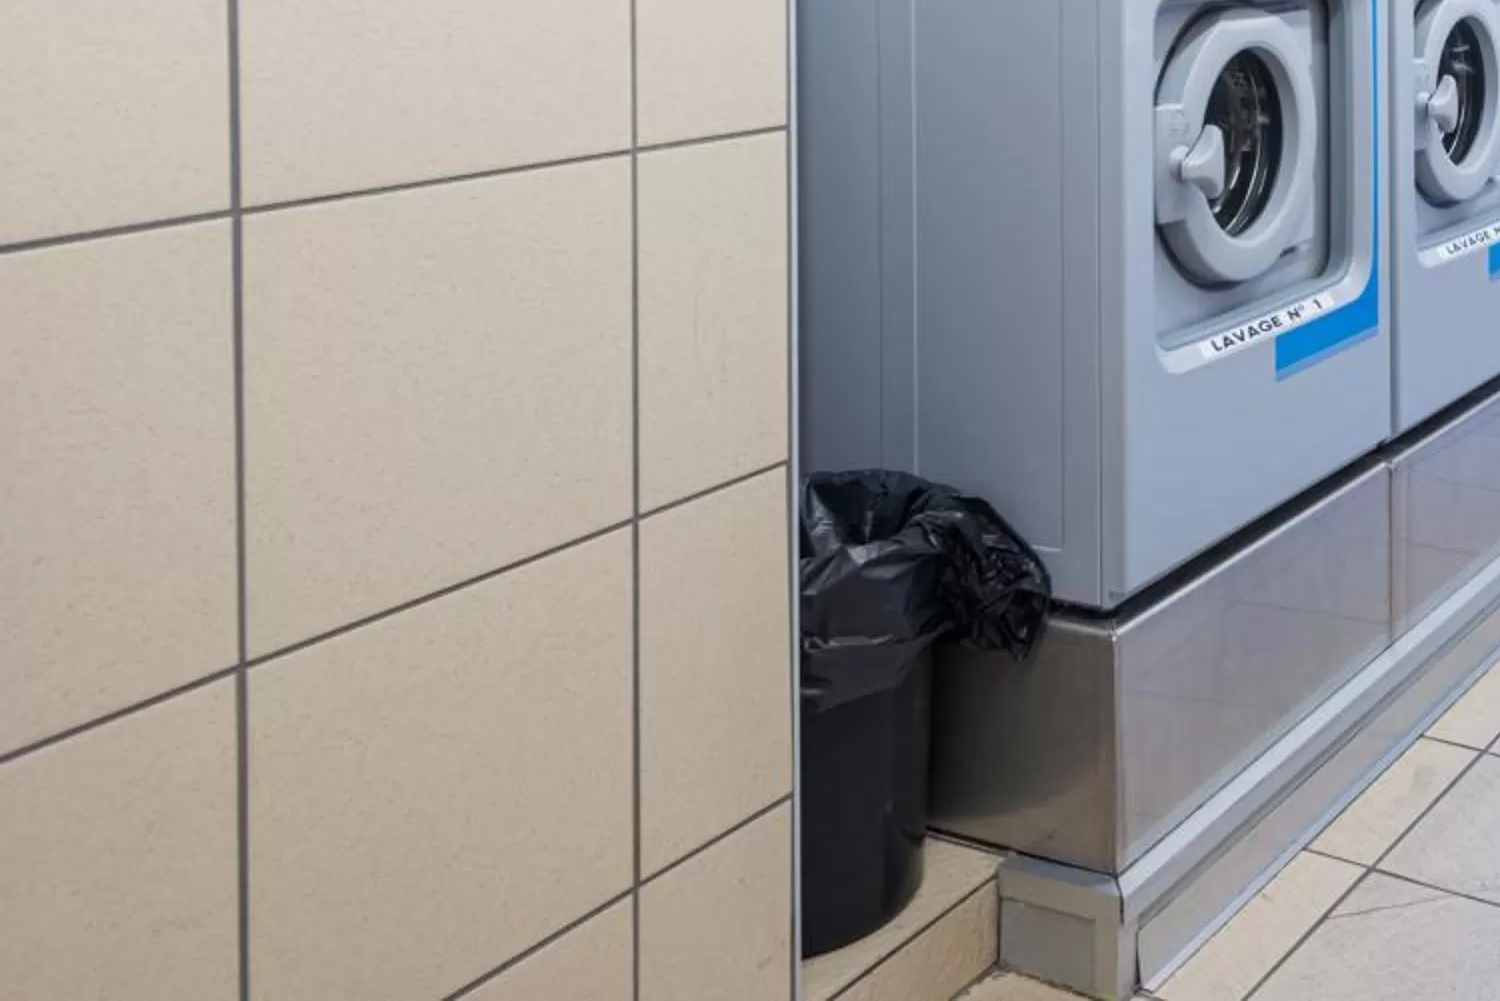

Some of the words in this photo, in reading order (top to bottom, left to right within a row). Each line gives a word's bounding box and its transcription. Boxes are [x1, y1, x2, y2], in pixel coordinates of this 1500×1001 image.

[1445, 230, 1491, 255] LAVAGE
[1210, 315, 1283, 352] LAVAGE
[1287, 303, 1305, 321] N°
[1313, 298, 1323, 310] 1
